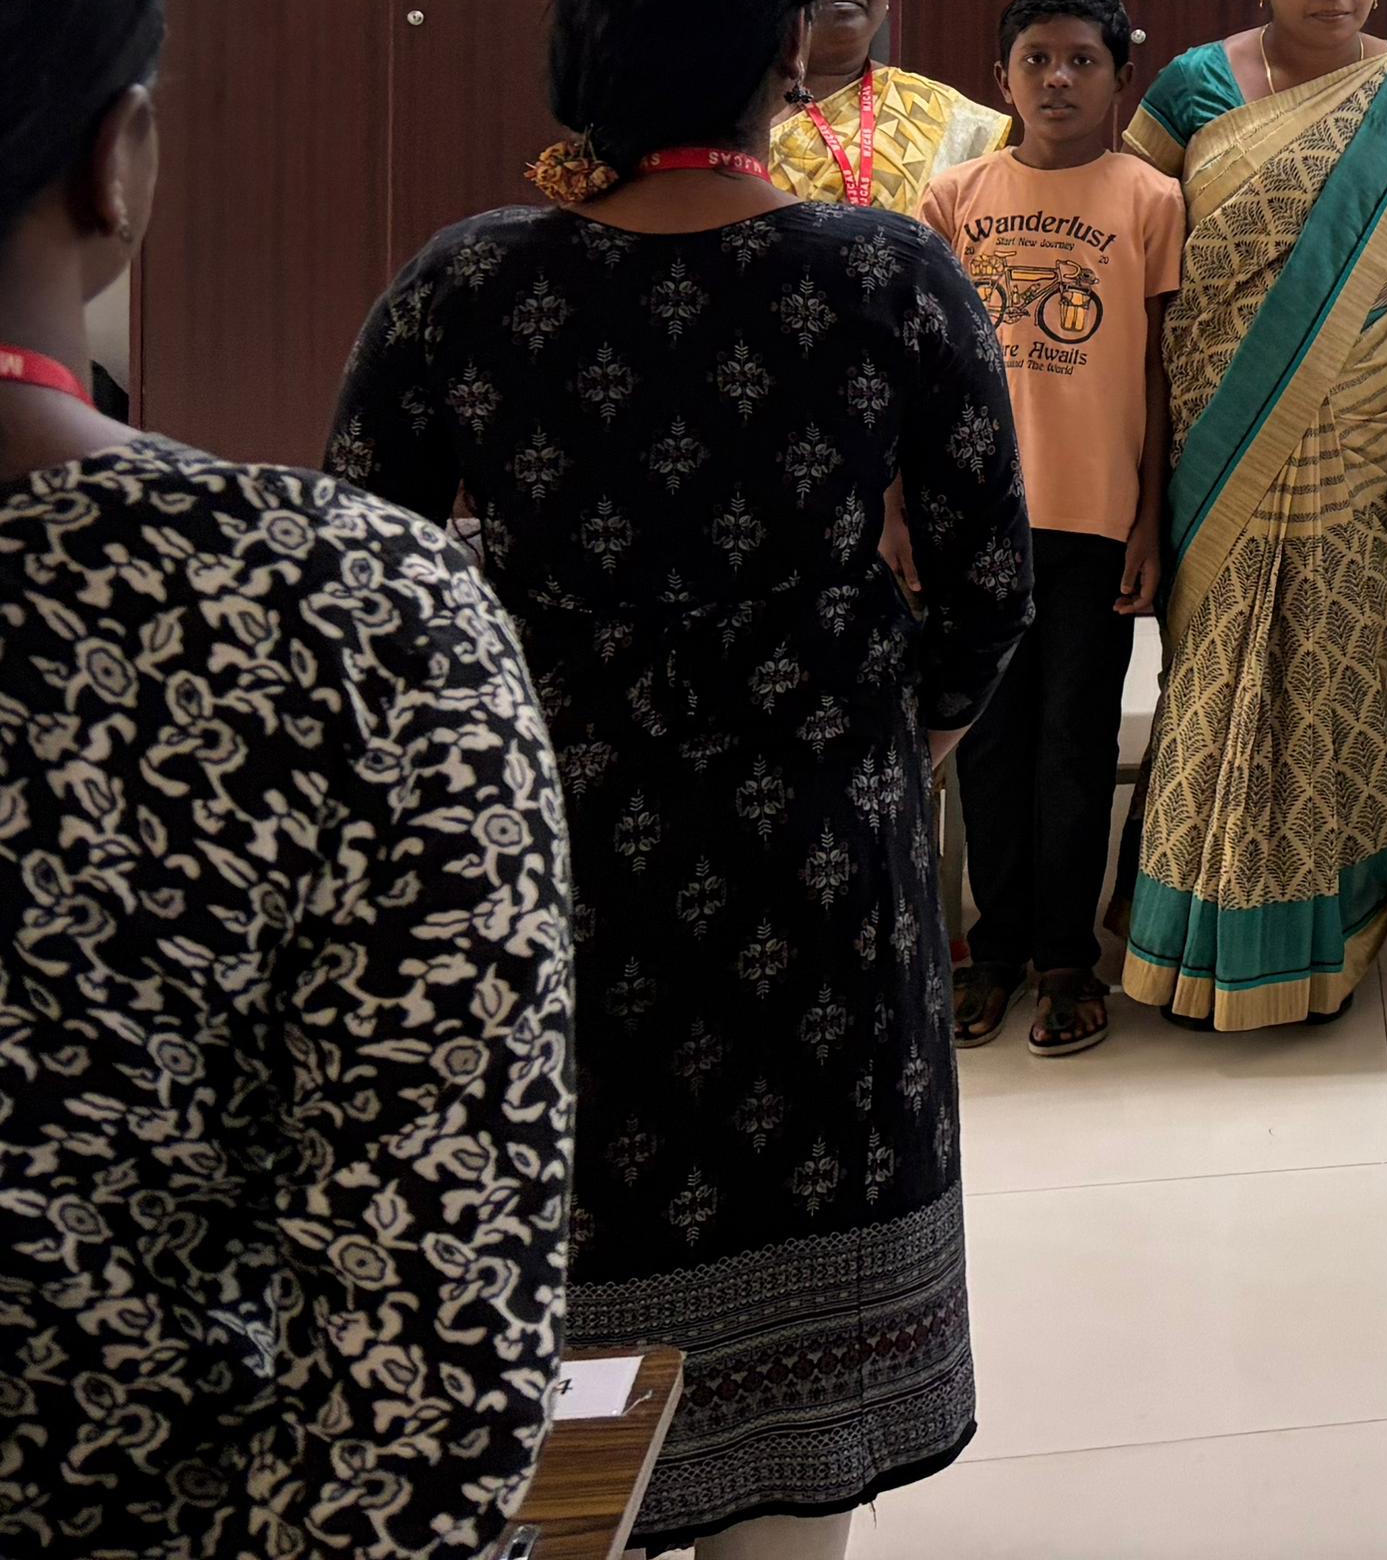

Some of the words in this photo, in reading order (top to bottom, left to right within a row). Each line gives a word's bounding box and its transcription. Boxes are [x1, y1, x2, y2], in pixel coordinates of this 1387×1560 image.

[964, 210, 1117, 252] Wanderlust
[996, 237, 1016, 247] Start
[1018, 237, 1038, 247] New
[1040, 239, 1075, 251] Journey
[1028, 341, 1088, 366] Awaits
[1027, 359, 1045, 371] The
[1046, 361, 1074, 376] World
